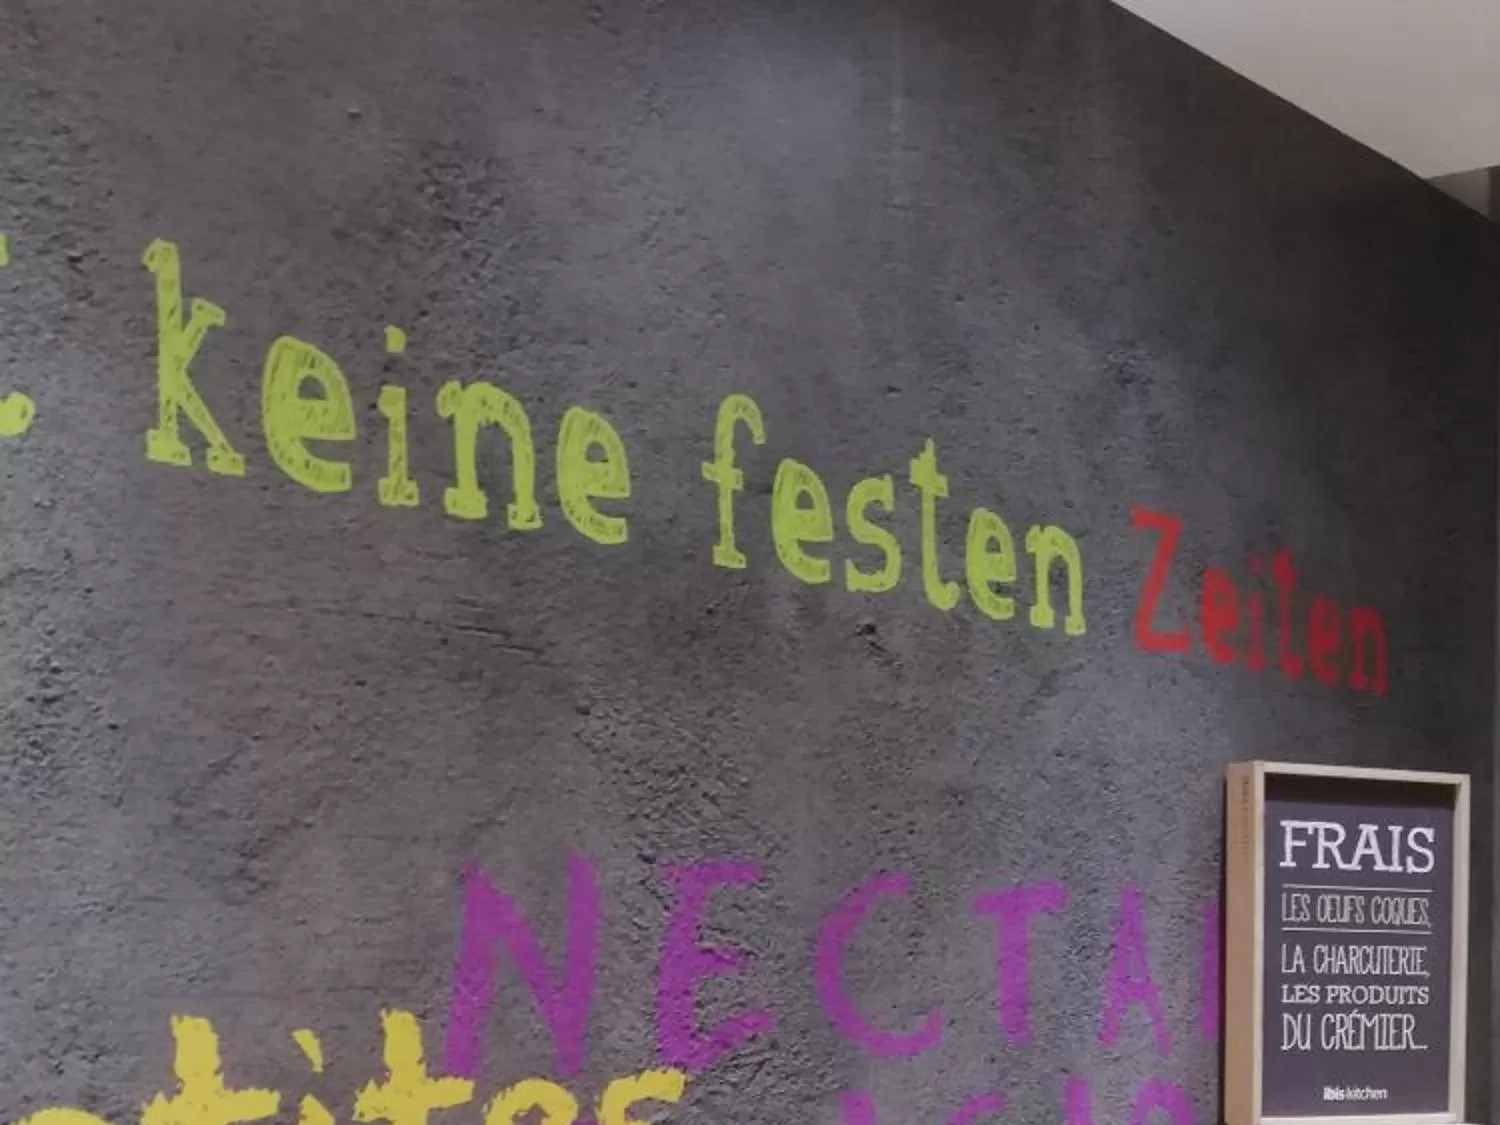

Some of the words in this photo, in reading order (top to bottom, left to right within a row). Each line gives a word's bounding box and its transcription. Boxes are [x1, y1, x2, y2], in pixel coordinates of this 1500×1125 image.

[143, 237, 631, 544] keine
[702, 394, 1086, 636] festen
[1130, 504, 1389, 695] Zeiten
[1279, 819, 1435, 873] FRAIS
[1281, 892, 1311, 921] LES
[1281, 944, 1306, 973] LA
[1281, 985, 1320, 1003] LES
[1326, 985, 1430, 1005] PRODUITS
[1280, 1013, 1311, 1050] DU
[1323, 1085, 1345, 1100] ibis
[1346, 1086, 1388, 1101] kitchen
